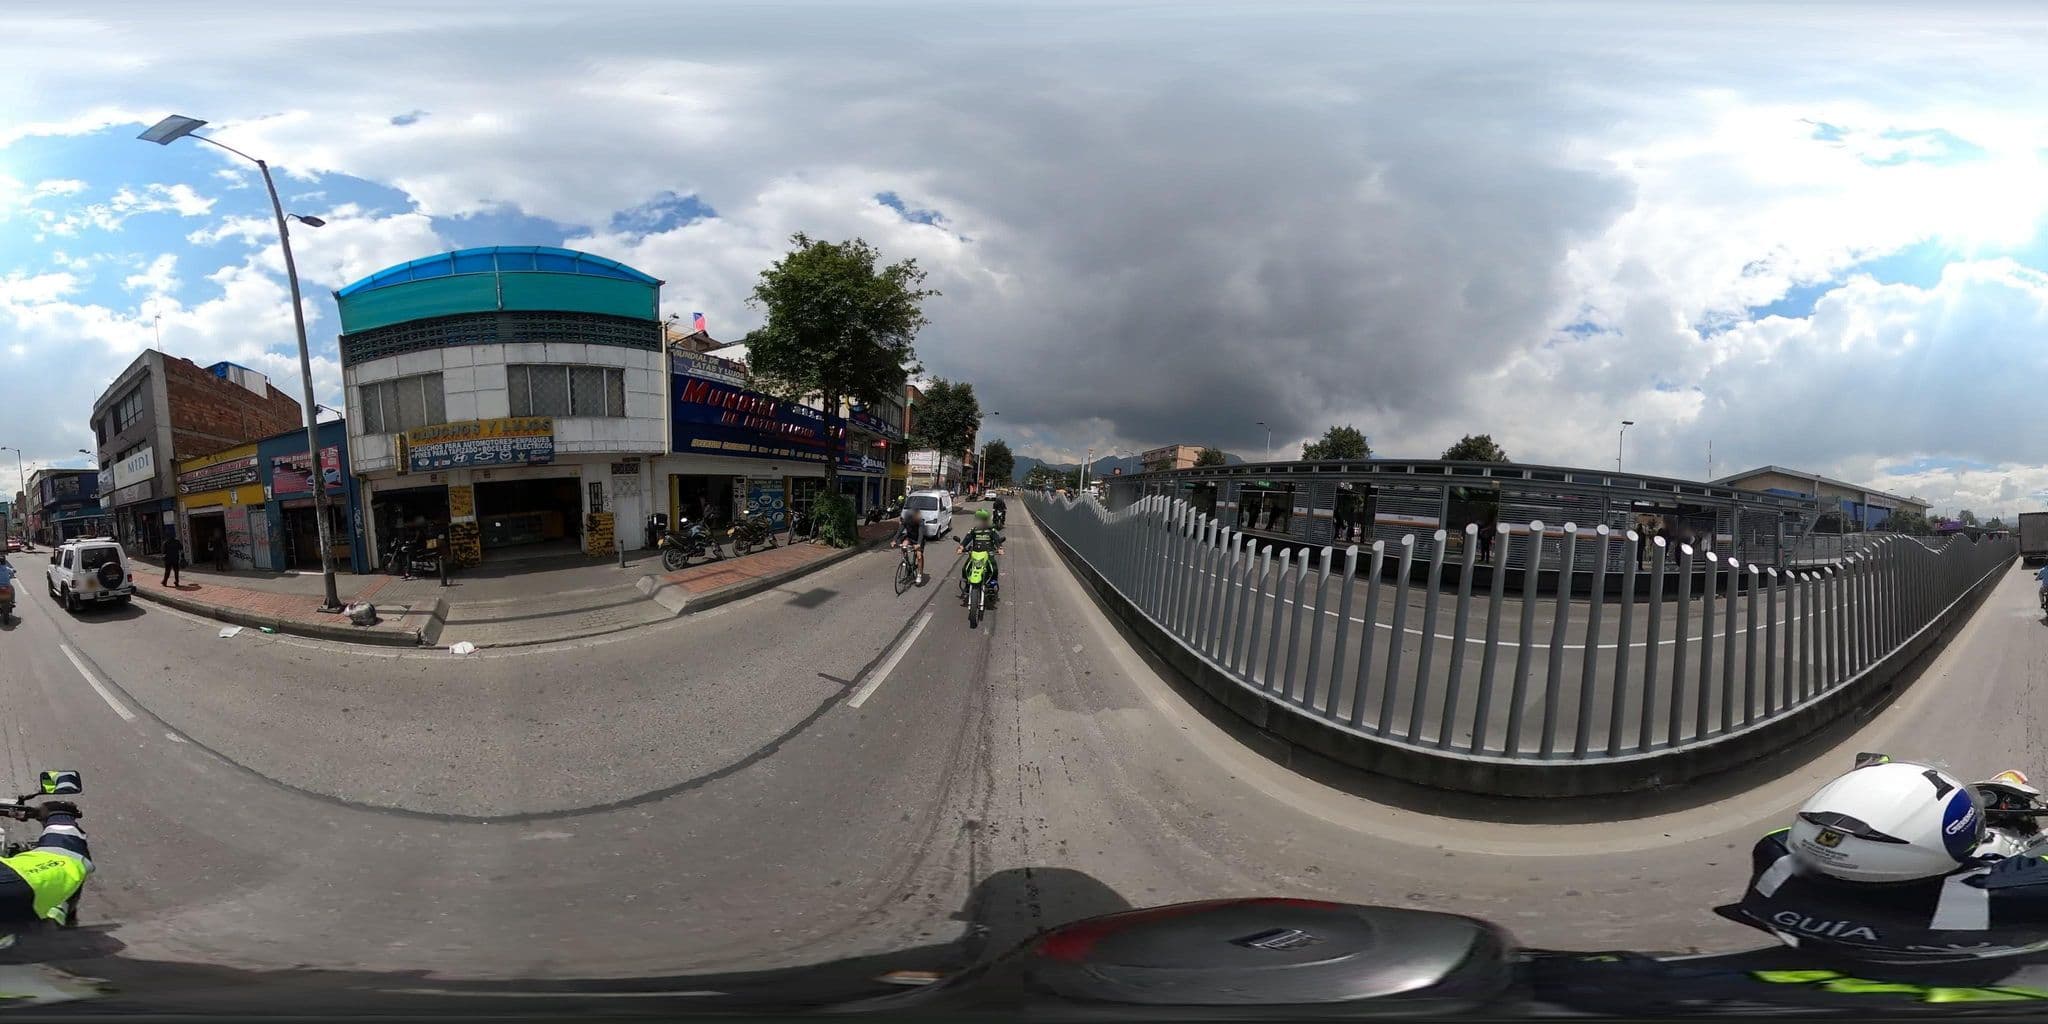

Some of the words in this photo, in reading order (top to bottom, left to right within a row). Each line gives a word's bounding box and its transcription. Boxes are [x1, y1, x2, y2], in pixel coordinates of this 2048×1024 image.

[672, 350, 707, 361] MUNDIAL
[709, 357, 720, 365] DE
[691, 361, 717, 371] LATAS
[724, 369, 745, 379] LUJOS
[415, 444, 444, 453] CAUCHOS
[445, 442, 462, 450] PARA
[463, 438, 513, 447] AUTOMOTORES
[516, 436, 550, 444] EMPAQUES
[432, 449, 449, 457] PARA
[127, 454, 150, 473] MIDI
[1773, 911, 1878, 941] GUÍA
